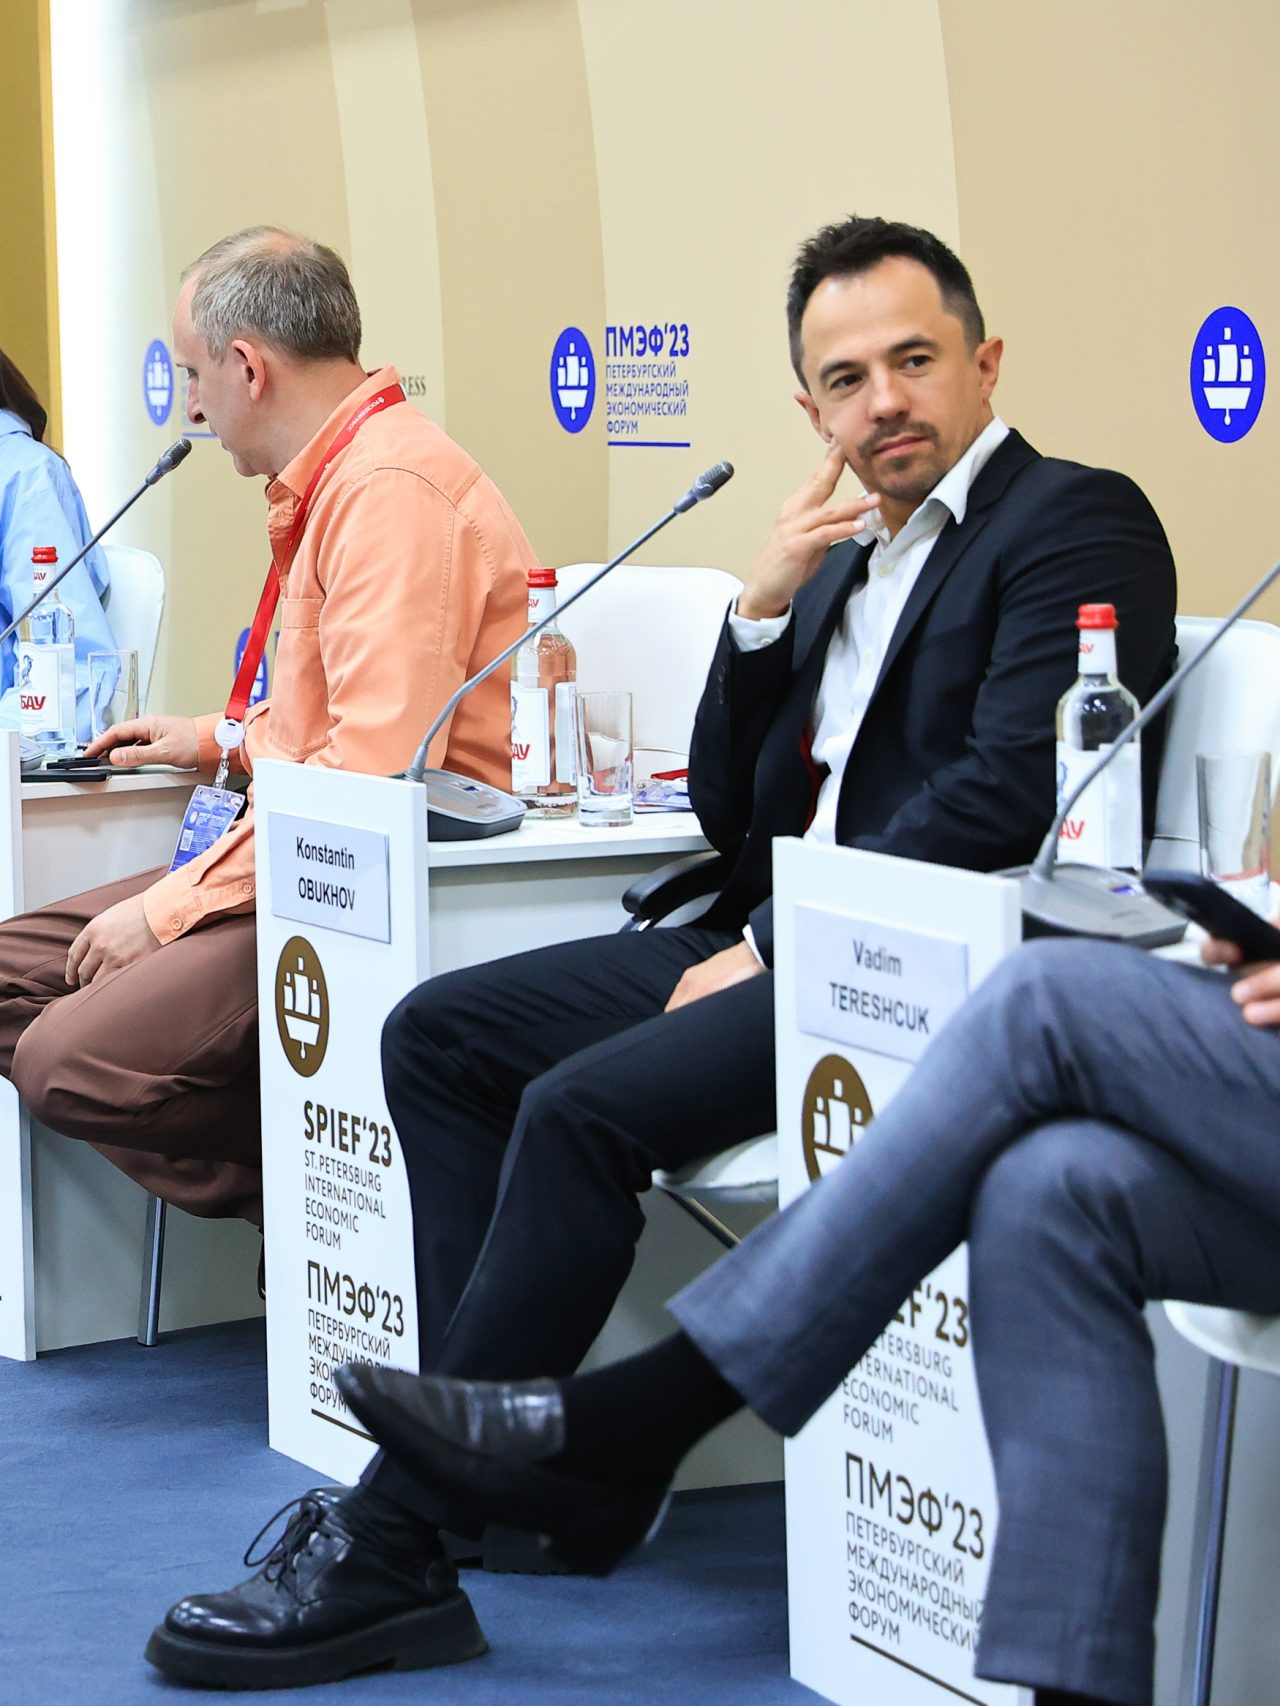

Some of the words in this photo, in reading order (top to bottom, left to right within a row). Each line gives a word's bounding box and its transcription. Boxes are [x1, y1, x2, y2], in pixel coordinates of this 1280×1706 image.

[606, 361, 676, 378] ПЕТЕРБУРГСКИЙ
[606, 380, 688, 398] МЕЖДУНАРОДНЫЙ
[606, 399, 687, 416] ЭКОНОМИЧЕСКИЙ
[606, 420, 638, 434] ФОРУМ
[20, 694, 46, 711] БАУ
[296, 836, 354, 870] Konstantin
[298, 876, 355, 911] OBUKHOV
[852, 938, 902, 977] Vadim
[829, 981, 929, 1035] TERESHCUK
[305, 1149, 318, 1170] ST.
[320, 1155, 381, 1192] PETERSBURG
[305, 1173, 386, 1219] INTERNATIONAL
[305, 1197, 359, 1233] ECONOMIC
[306, 1221, 341, 1251] FORUM
[308, 1308, 390, 1360] ПЕТЕРБУРГСКИЙ
[310, 1382, 347, 1413] ФОРУМ
[843, 1377, 920, 1425] ECONOMIC
[843, 1403, 893, 1443] FORUM
[846, 1511, 964, 1587] ПЕТЕРБУРГСКИЙ
[849, 1601, 900, 1646] ФОРУМ
